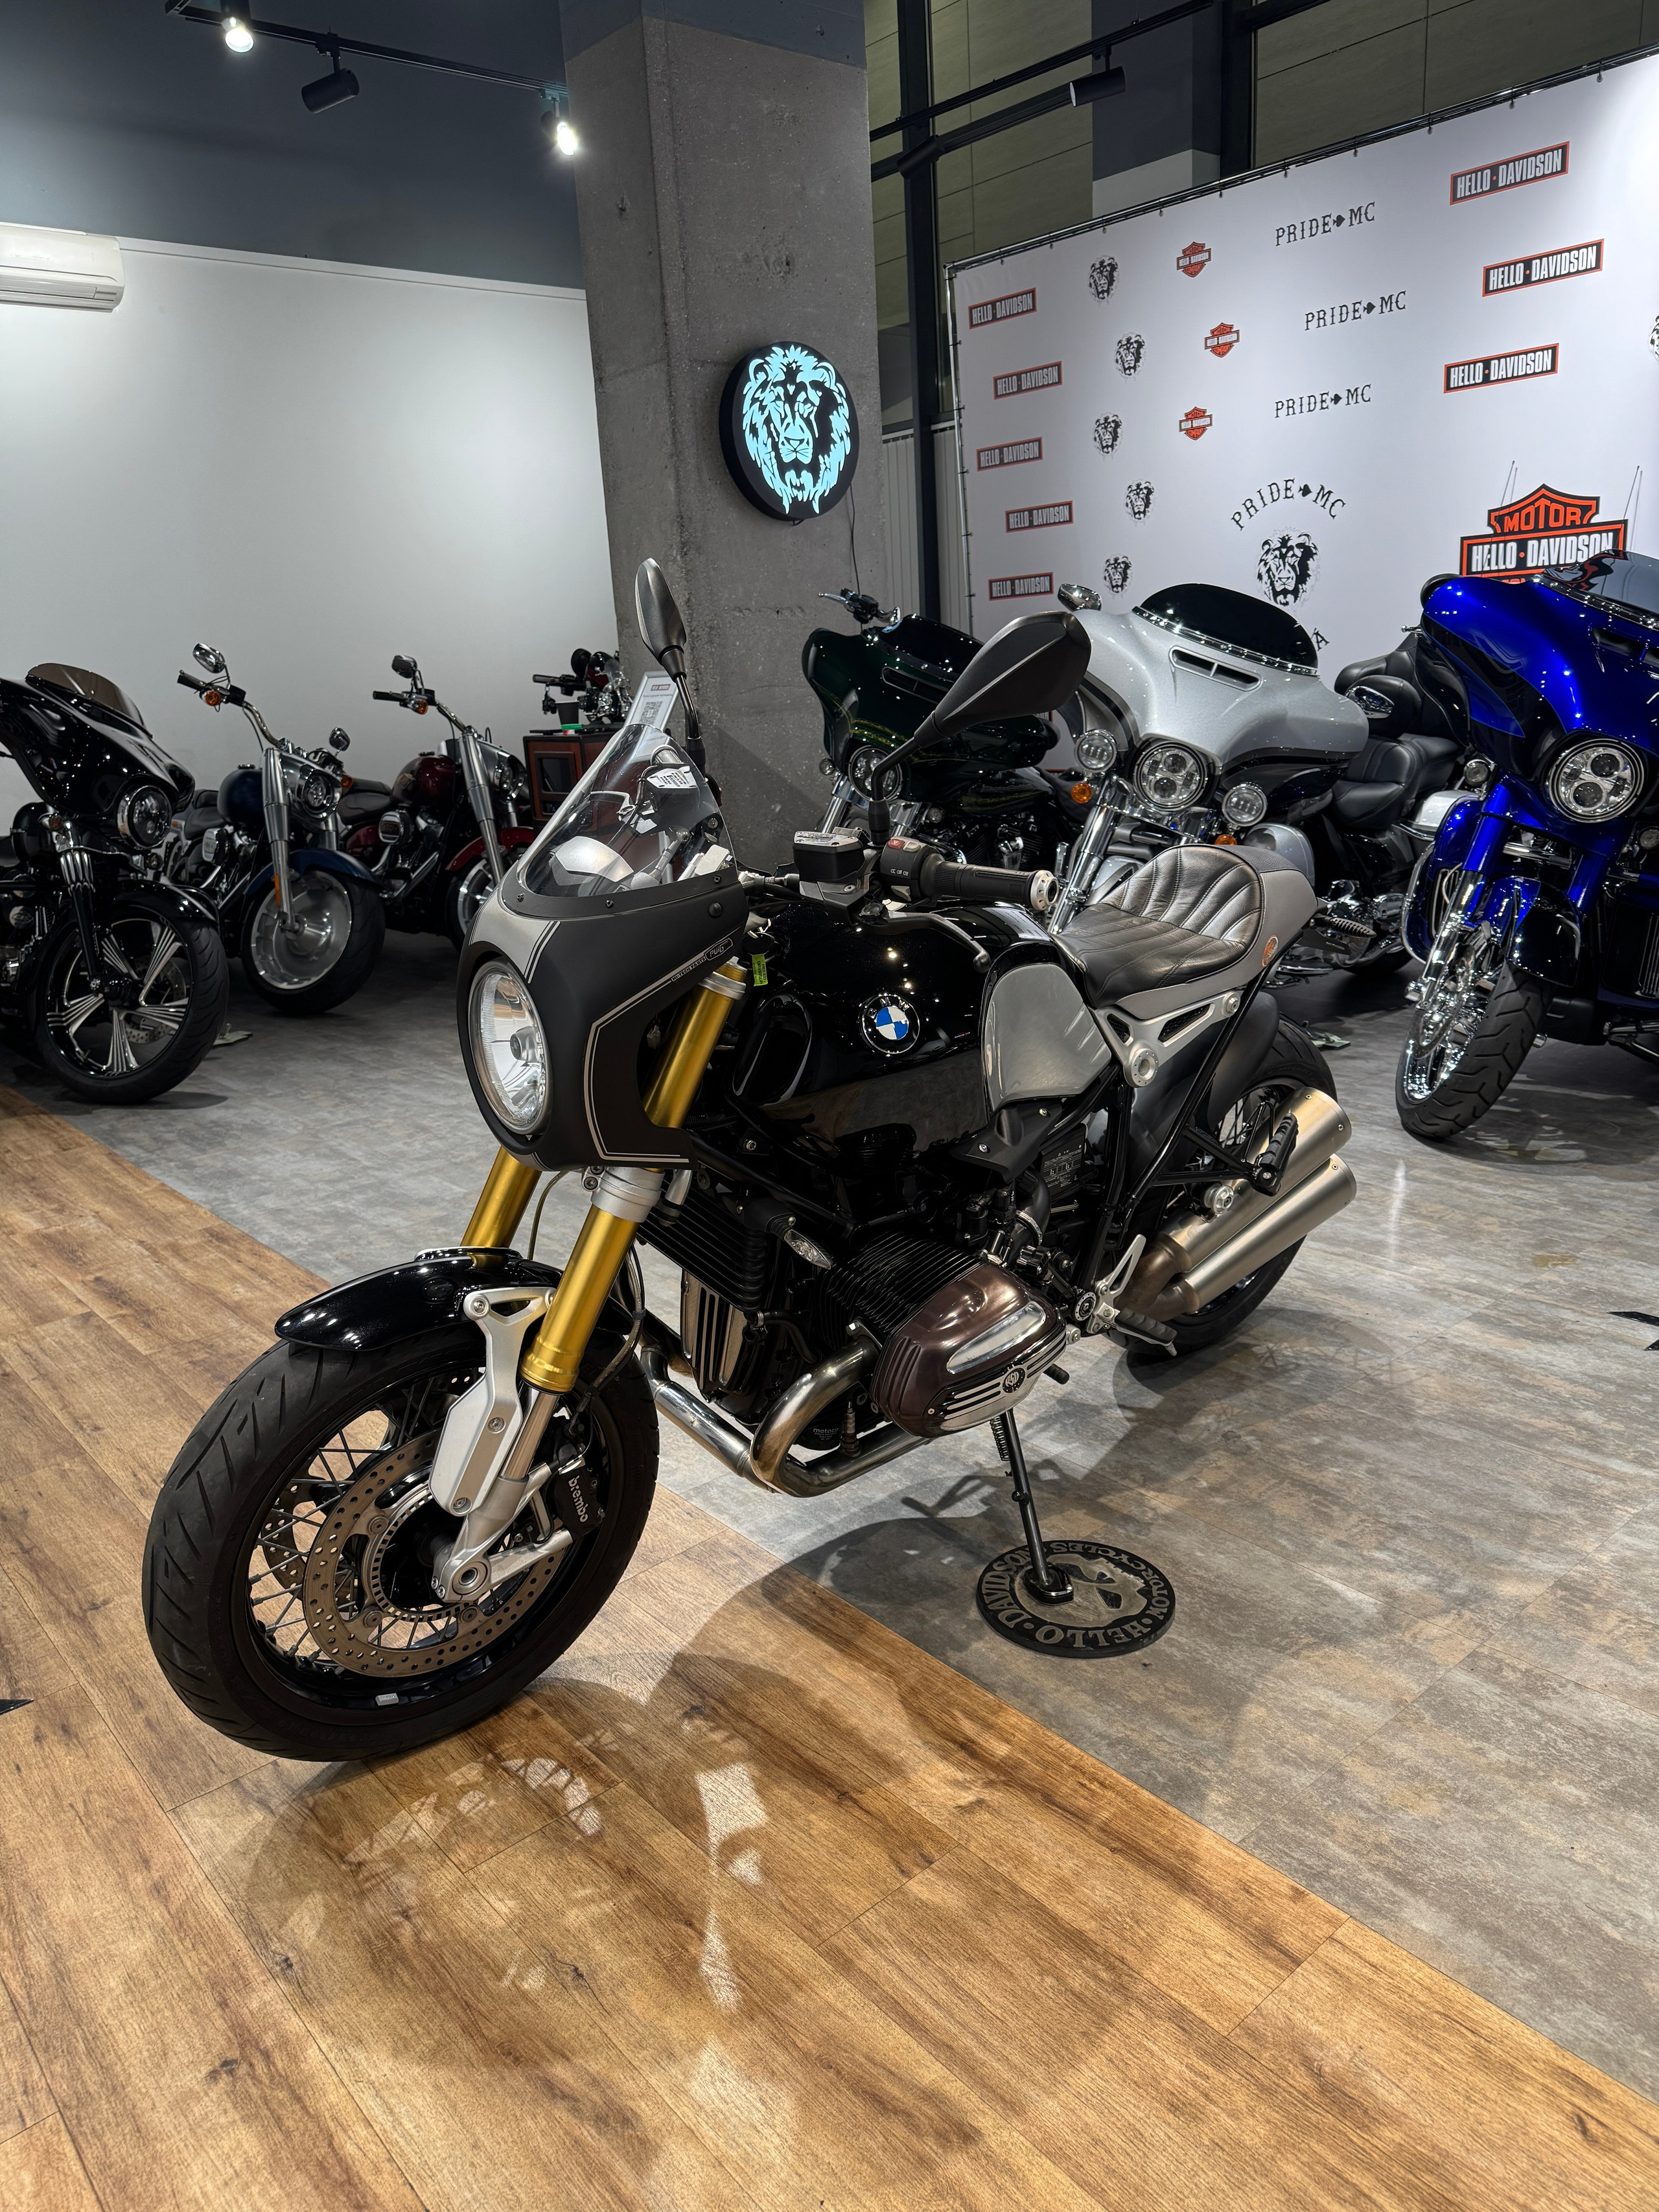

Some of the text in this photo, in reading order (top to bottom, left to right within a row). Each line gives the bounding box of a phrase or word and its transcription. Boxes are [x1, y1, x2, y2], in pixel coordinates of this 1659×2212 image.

[1457, 149, 1562, 198] HELLO DAVIDSON
[1276, 202, 1375, 246] PRIDE MC
[1489, 246, 1597, 291] HELLO DAVIDSON
[972, 293, 1033, 325] HELLO DAVIDSON
[1305, 290, 1406, 331] PRIDE MC
[997, 366, 1058, 395] HELLO DAVIDSON
[1450, 349, 1552, 388] HELLO DAVIDSON
[1275, 384, 1371, 417] PRIDE MC
[980, 442, 1039, 467] HELLO DAVIDSON
[1009, 505, 1069, 529] HELLO DAVIDSON
[1231, 478, 1346, 530] PRIDE MC
[1503, 498, 1582, 533] MOTOR
[1472, 532, 1614, 572] HELLO DAVIDSON
[992, 576, 1050, 598] HELLO DAVIDSON
[691, 957, 706, 970] PARTS
[867, 997, 910, 1019] BMW
[568, 1475, 588, 1522] brembo
[1050, 1542, 1170, 1620] MOTORCYCLES
[1036, 1621, 1152, 1648] HELLO
